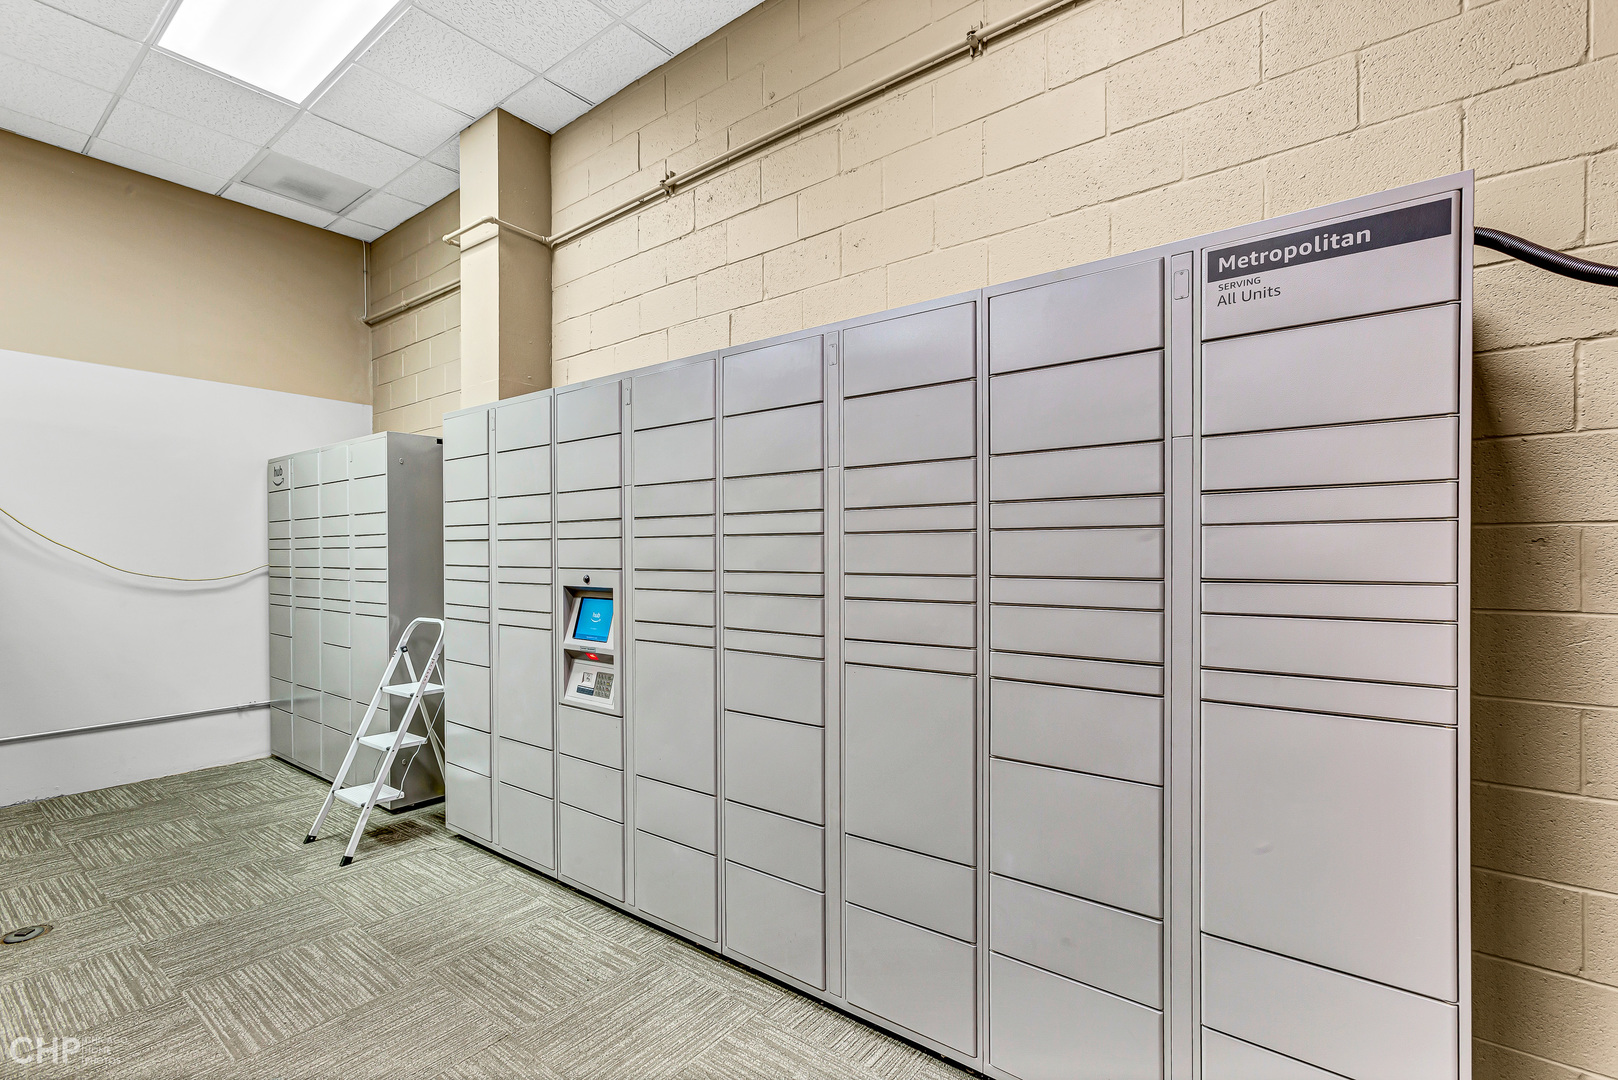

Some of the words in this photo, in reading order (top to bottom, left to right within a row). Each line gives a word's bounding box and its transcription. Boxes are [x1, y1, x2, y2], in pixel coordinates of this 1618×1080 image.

[1218, 229, 1371, 273] Metropolitan
[1218, 276, 1261, 292] SERVING
[1217, 293, 1237, 307] All
[1241, 285, 1281, 302] Units
[273, 465, 283, 477] hub
